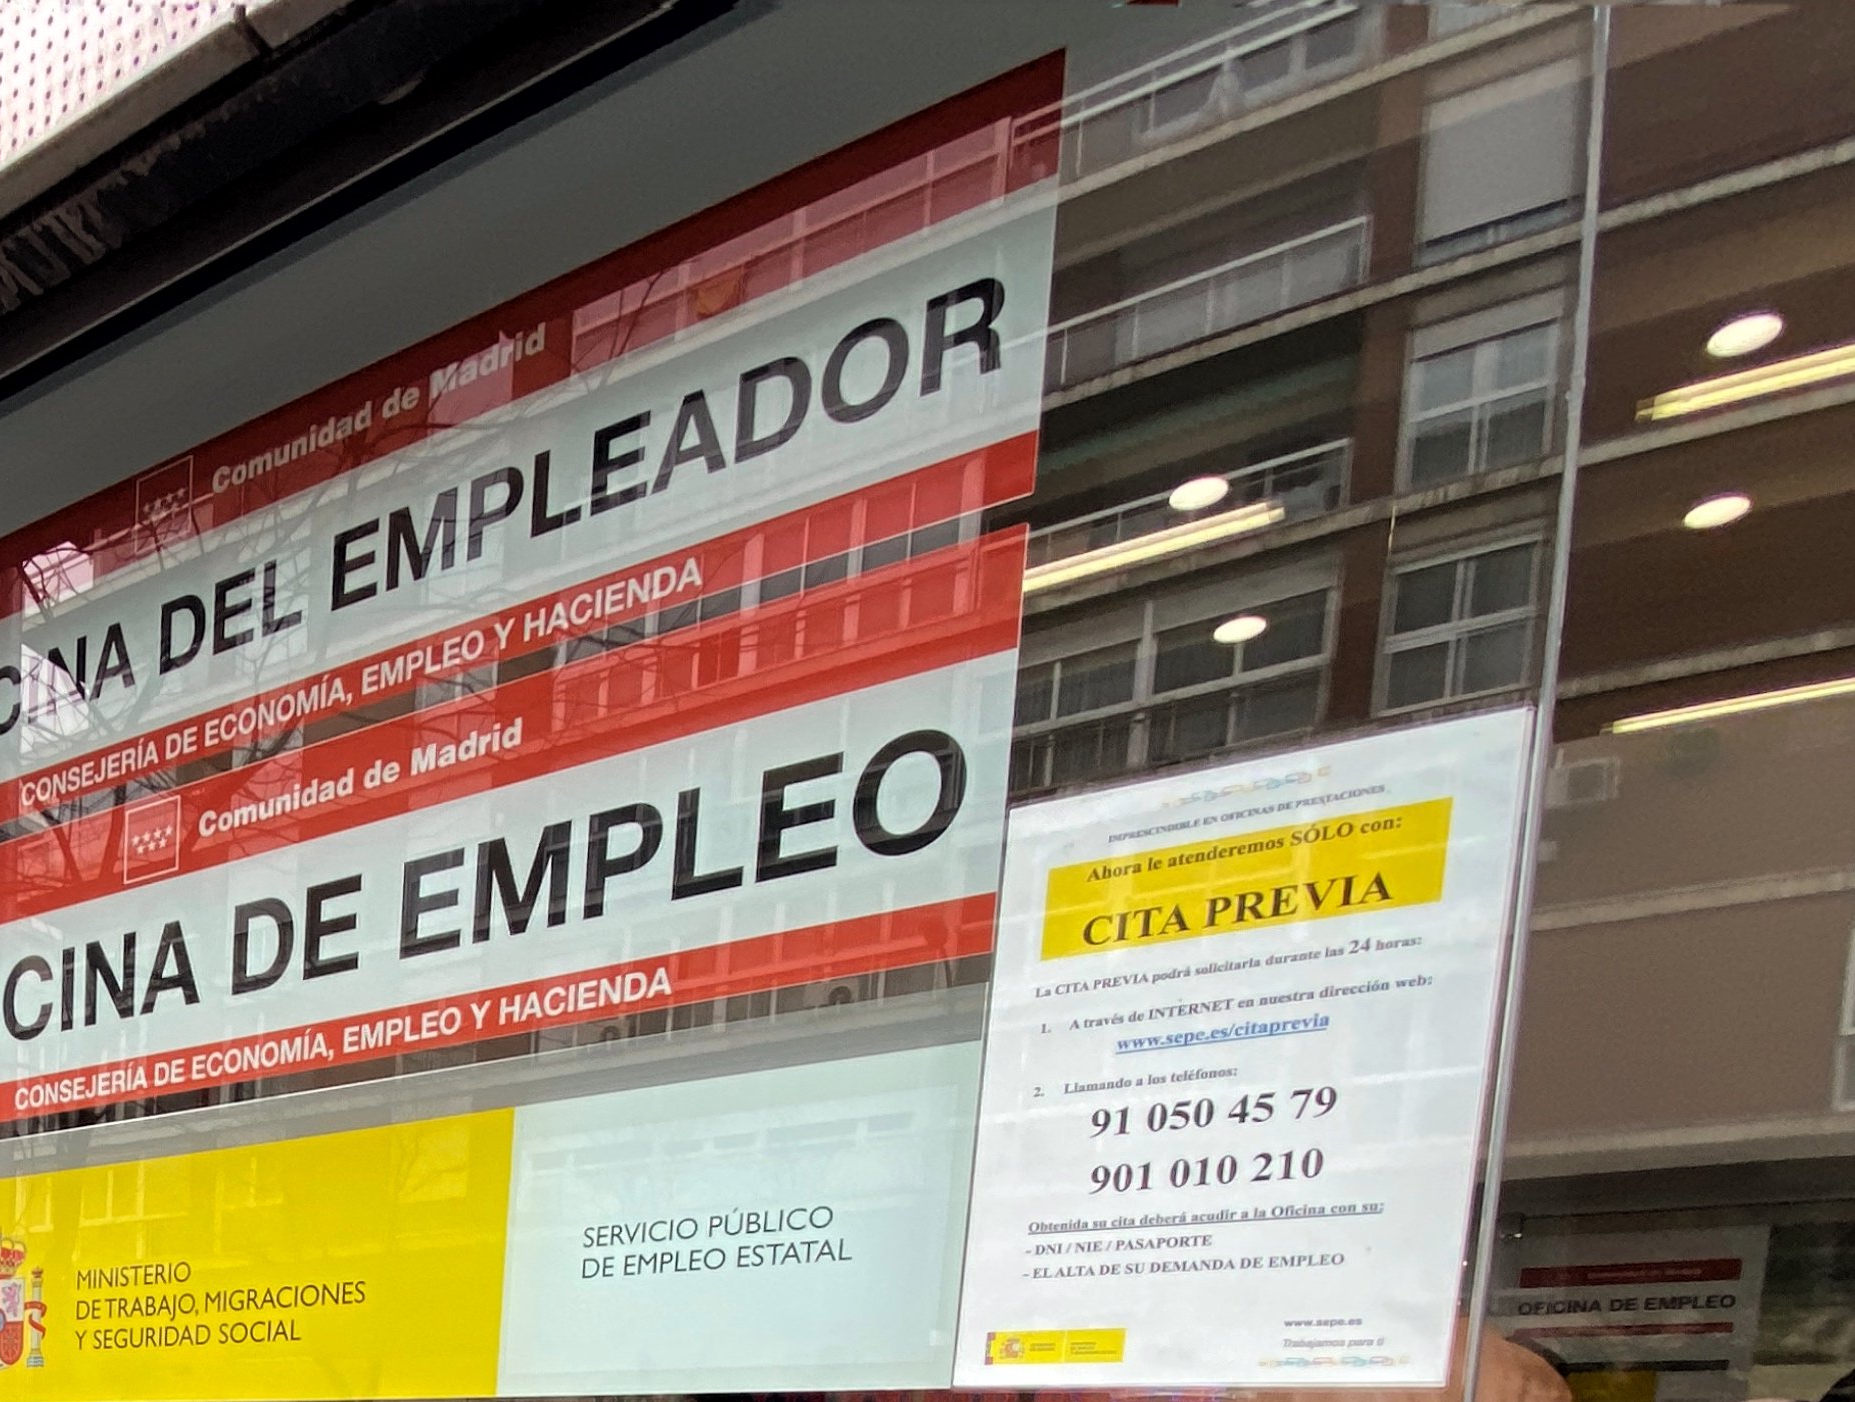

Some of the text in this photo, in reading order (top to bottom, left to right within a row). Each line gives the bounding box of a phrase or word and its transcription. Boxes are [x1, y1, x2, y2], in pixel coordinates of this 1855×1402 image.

[211, 324, 547, 496] Comunidad de Madrid
[159, 559, 303, 676] DEL
[331, 277, 1006, 611] EMPLEADOR
[20, 557, 703, 808] CONSEJERÍA DE ECONOMÍA, EMPLEO Y HACIENDA
[198, 717, 523, 839] Comunidad de Madrid
[1202, 815, 1219, 826] EN
[1277, 801, 1293, 813] DE
[230, 873, 363, 997] DE
[400, 729, 968, 960] EMPLEO
[1087, 815, 1403, 883] Ahora le atenderemos SÓLO con:
[1083, 870, 1393, 947] CITA PREVIA
[1035, 935, 1423, 999] La CITA PREVIA podrá solicitarla durante las 24 horas:
[1041, 974, 1434, 1035] 1. A través de INTERNET en nuestra dirección web:
[13, 967, 673, 1111] CONSEJERÍA DE ECONOMÍA, EMPLEO Y HACIENDA
[1115, 1013, 1331, 1054] www.sepe.es/citaprevia
[1033, 1085, 1045, 1099] 2.
[1064, 1075, 1133, 1095] Llamando
[1147, 1070, 1168, 1085] los
[1170, 1065, 1239, 1084] teléfonos:
[1090, 1086, 1338, 1138] 91 050 45 79
[1089, 1147, 1325, 1196] 901 010 210
[583, 1205, 835, 1248] SERVICIO PÚBLICO
[1028, 1219, 1089, 1235] Obtenida
[1092, 1219, 1108, 1231] su
[1111, 1215, 1137, 1229] cita
[1139, 1210, 1188, 1227] deberá
[1191, 1208, 1238, 1225] acudir
[1253, 1205, 1267, 1220] la
[1271, 1203, 1327, 1219] Oficina
[1330, 1204, 1357, 1217] con
[582, 1238, 853, 1279] DE EMPLEO ESTATAL
[1035, 1243, 1065, 1257] DNI
[1074, 1240, 1103, 1254] NIE
[1115, 1234, 1213, 1252] PASAPORTE
[1054, 1264, 1096, 1279] ALTA
[1099, 1263, 1122, 1276] DE
[1124, 1262, 1146, 1275] SU
[1148, 1257, 1236, 1275] DEMANDA
[1240, 1256, 1265, 1270] DE
[1268, 1252, 1346, 1269] EMPLEO
[76, 1260, 192, 1291] MINISTERIO
[75, 1280, 367, 1323] DE TRABAJO, MIGRACIONES
[1518, 1293, 1737, 1316] OFICINA DE EMPLEO
[75, 1318, 303, 1351] Y SEGURIDAD SOCIAL
